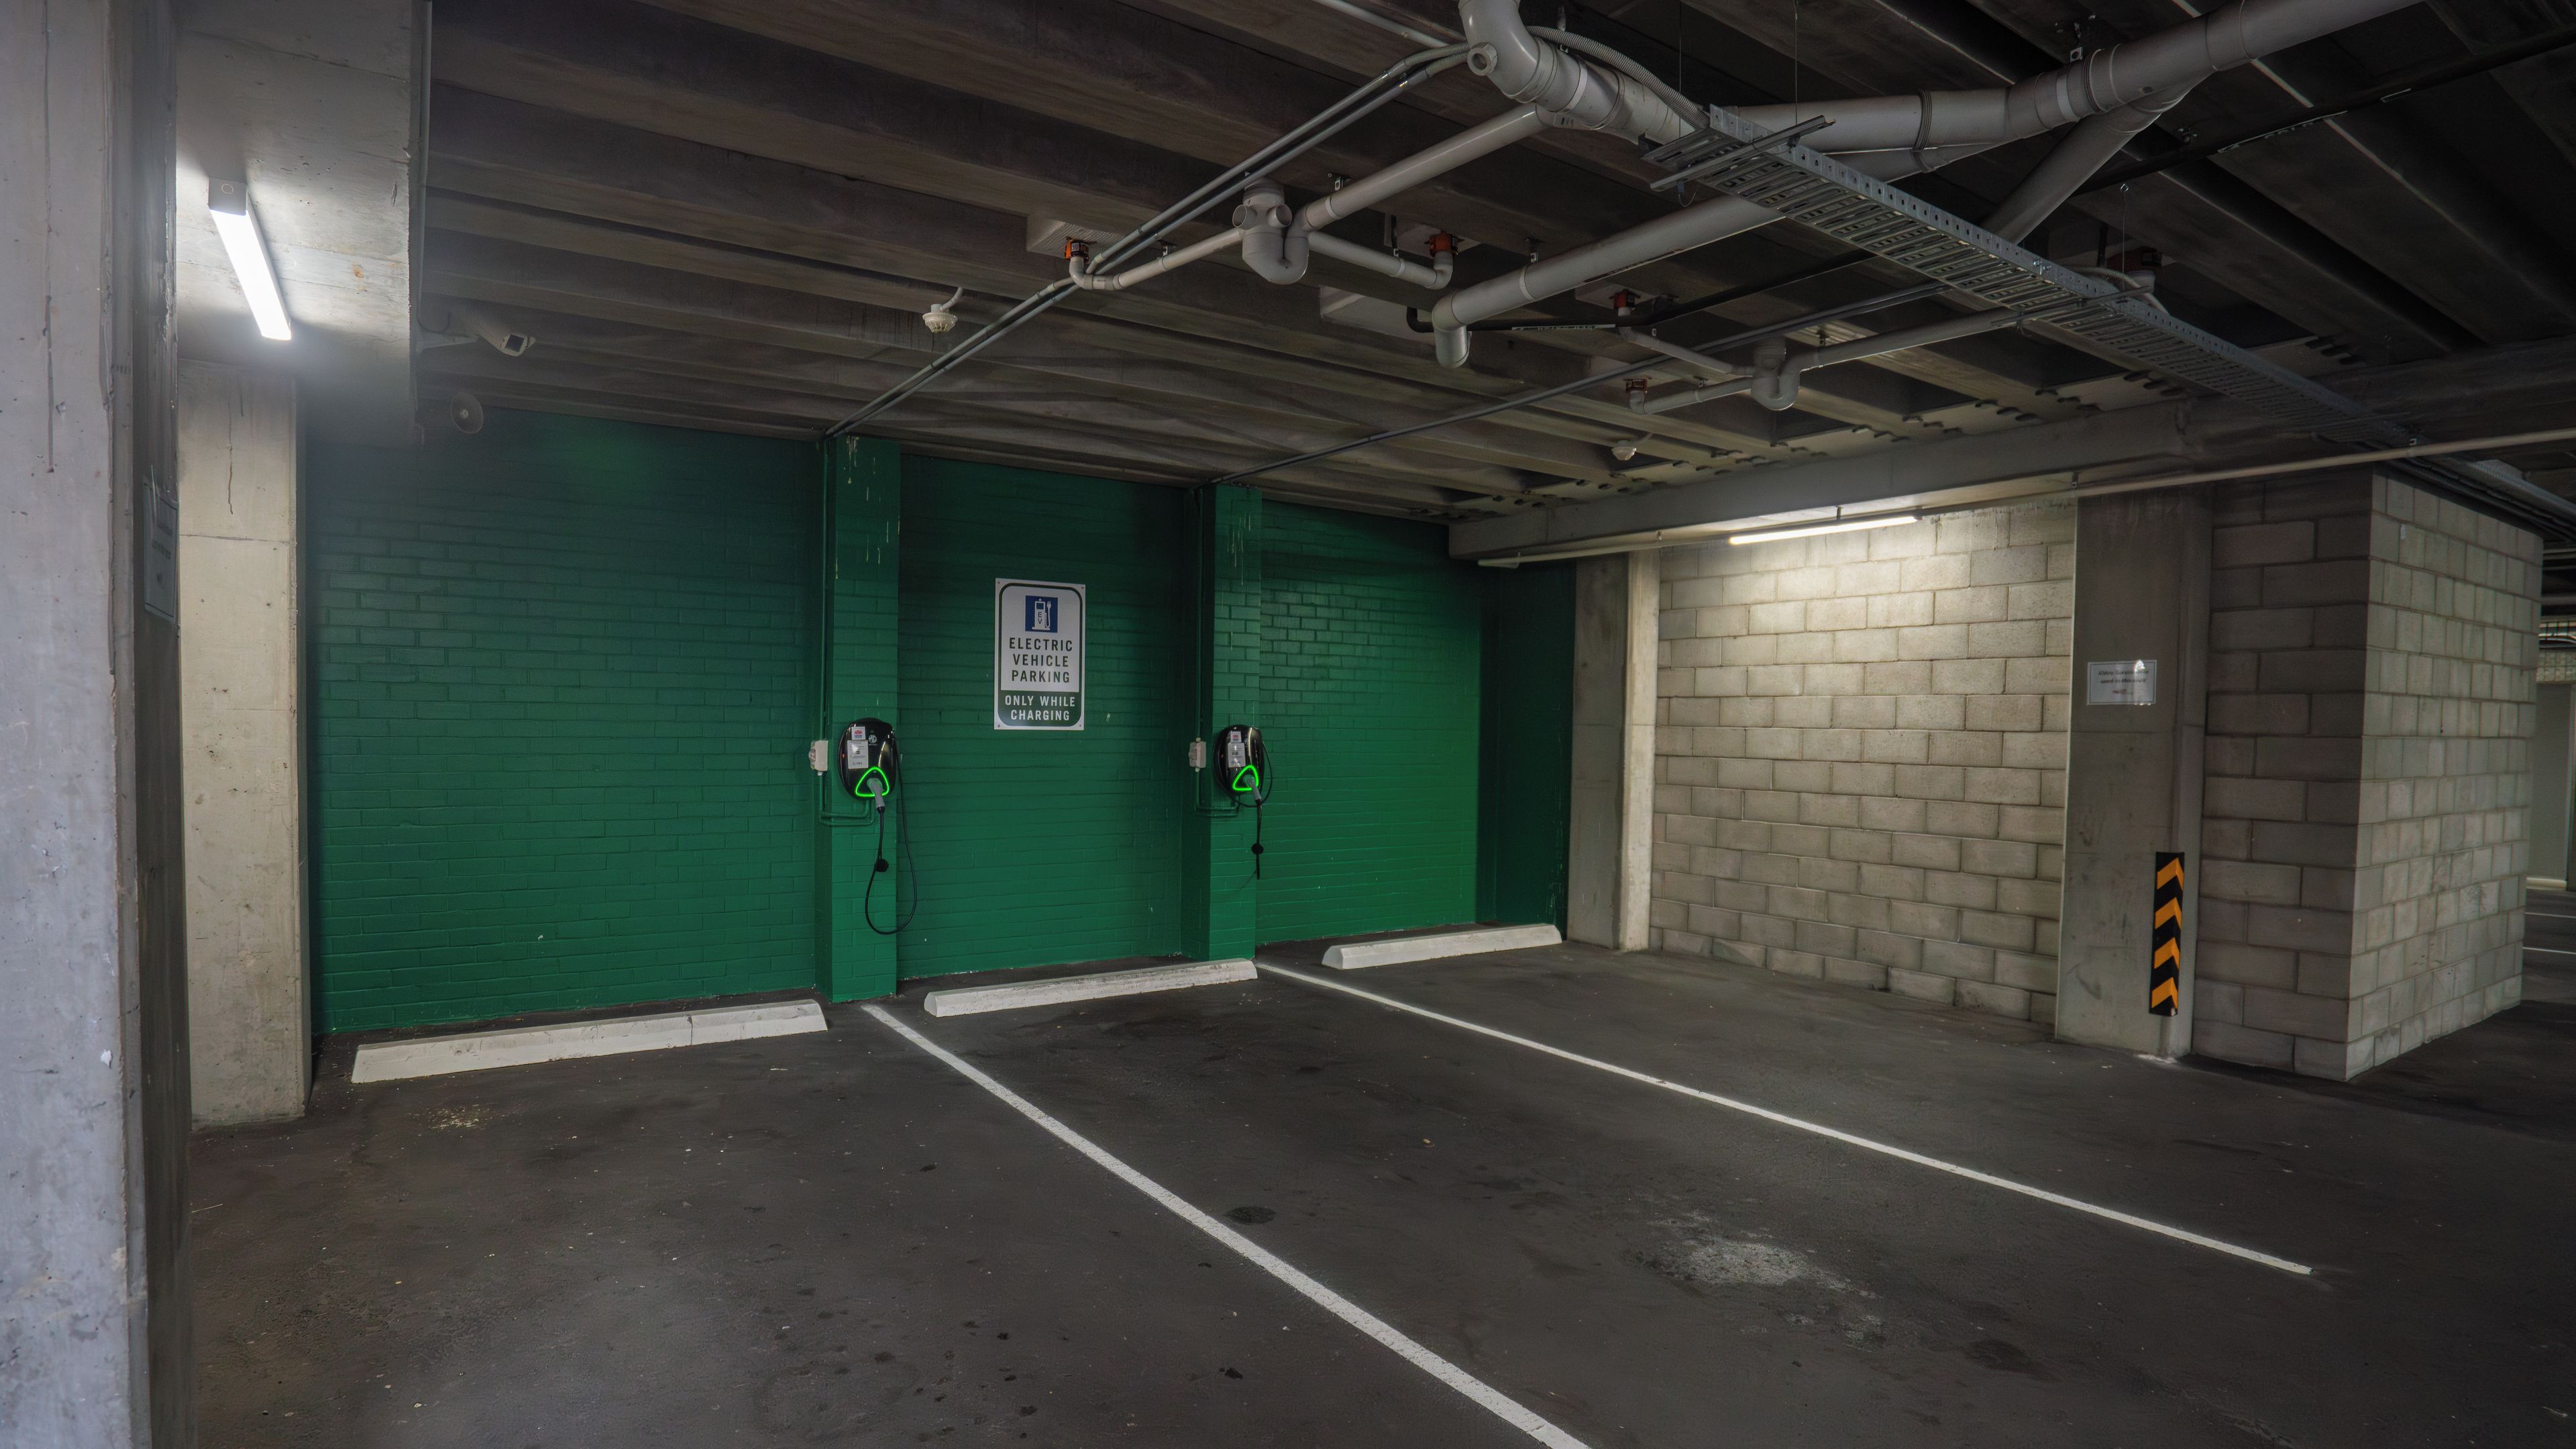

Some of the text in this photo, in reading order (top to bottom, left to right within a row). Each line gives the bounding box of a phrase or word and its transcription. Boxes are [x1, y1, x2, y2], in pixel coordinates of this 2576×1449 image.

[1009, 637, 1073, 651] ELECTRIC
[1013, 653, 1069, 667] VEHICLE
[1012, 669, 1070, 683] PARKING
[1005, 695, 1075, 707] ONLY WHILE
[1011, 710, 1069, 720] CHARGING
